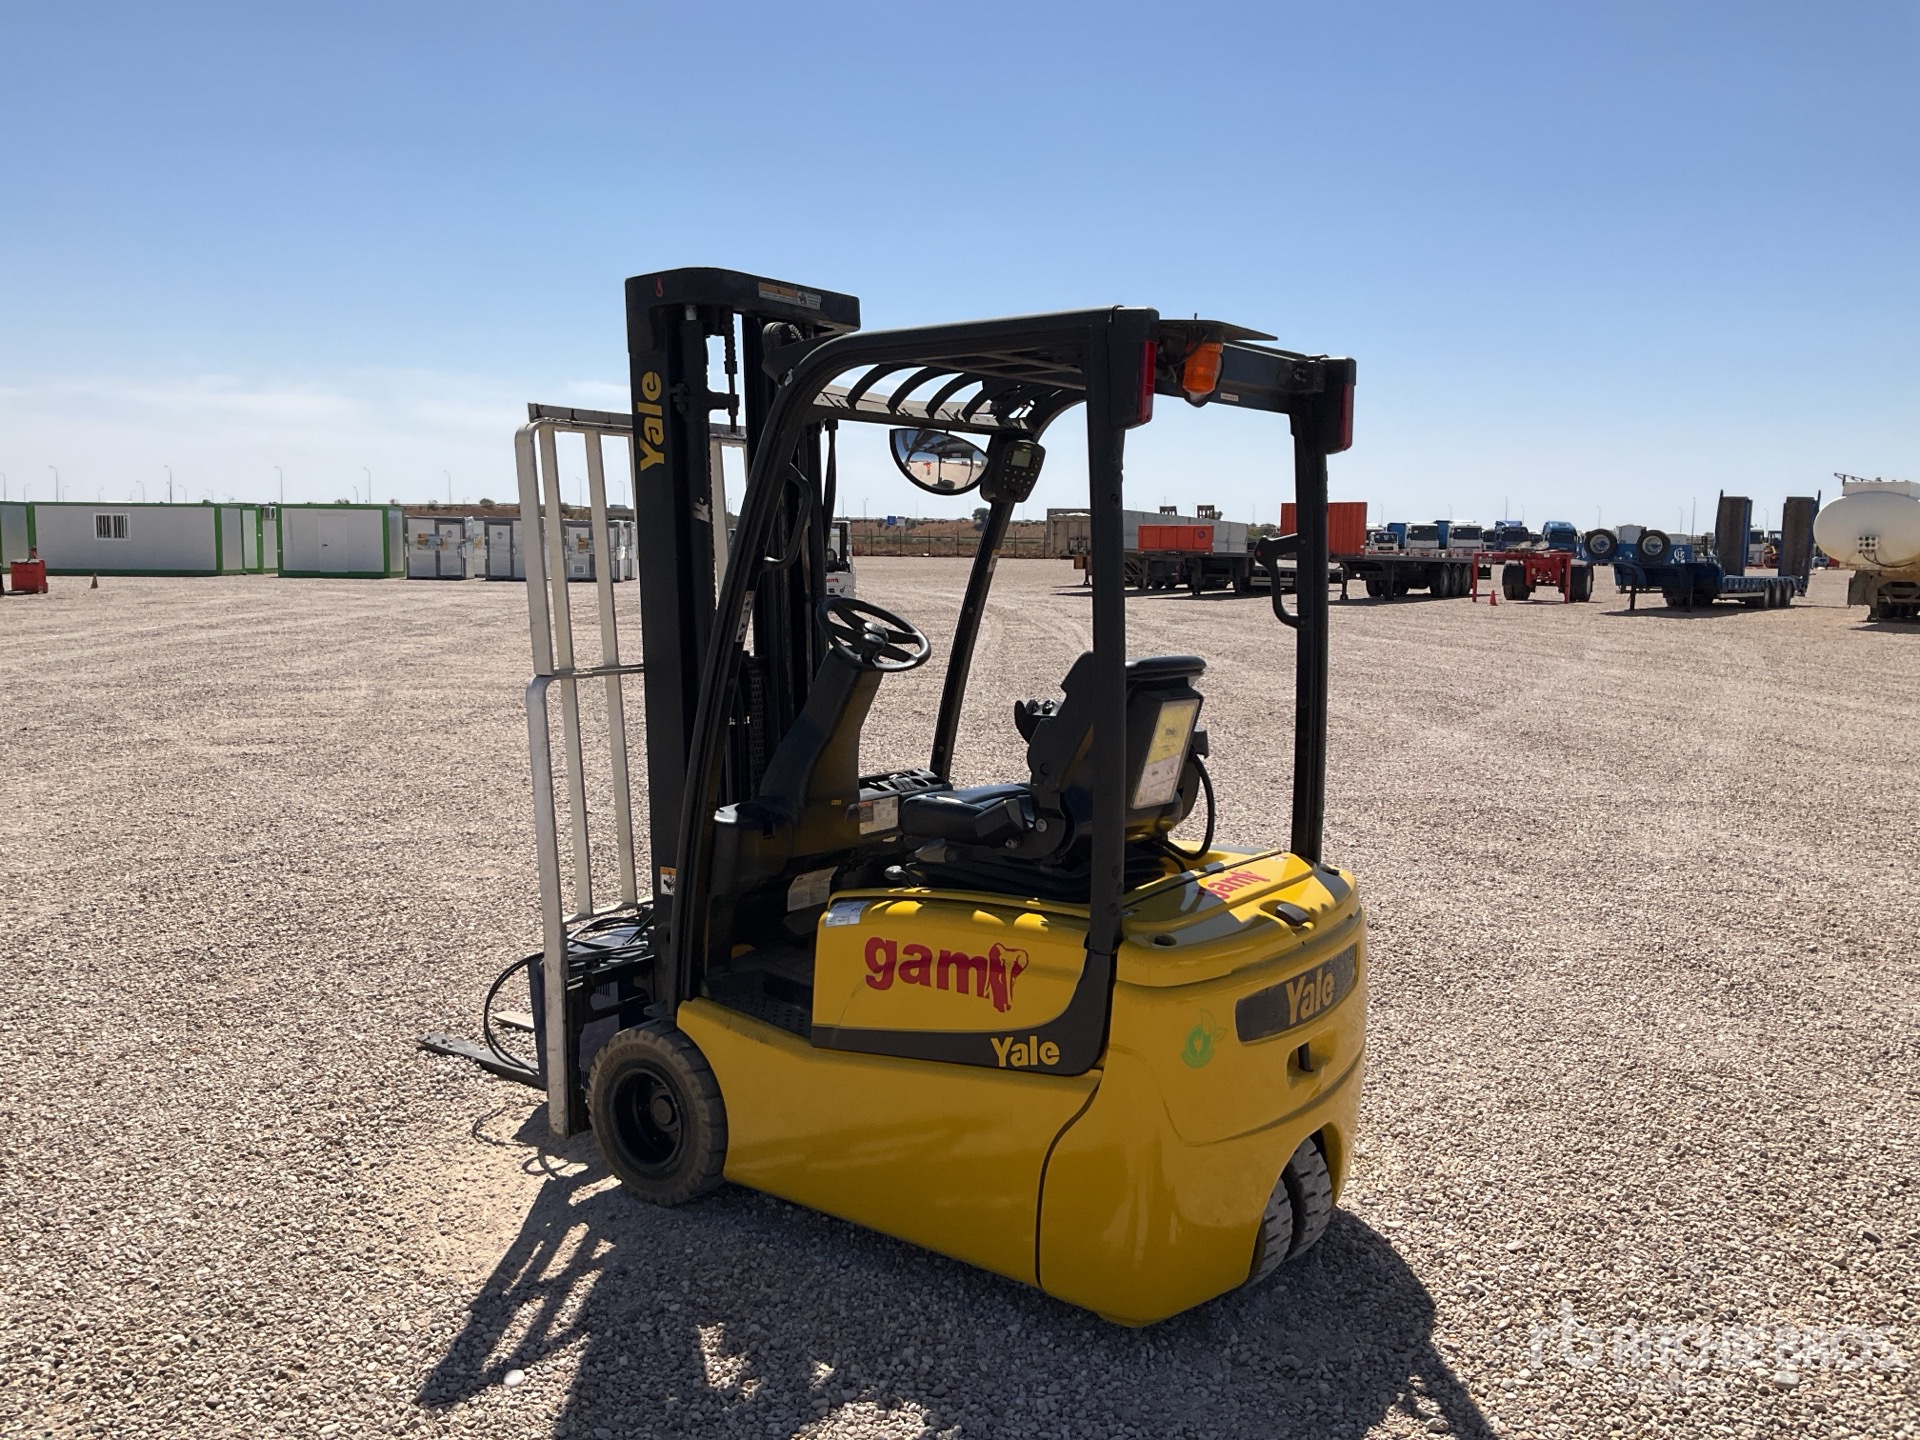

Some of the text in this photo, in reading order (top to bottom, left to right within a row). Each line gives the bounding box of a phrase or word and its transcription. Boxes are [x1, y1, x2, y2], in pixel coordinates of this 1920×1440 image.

[637, 371, 665, 471] Yale
[1286, 968, 1335, 1025] Yale
[990, 1035, 1060, 1067] Yale
